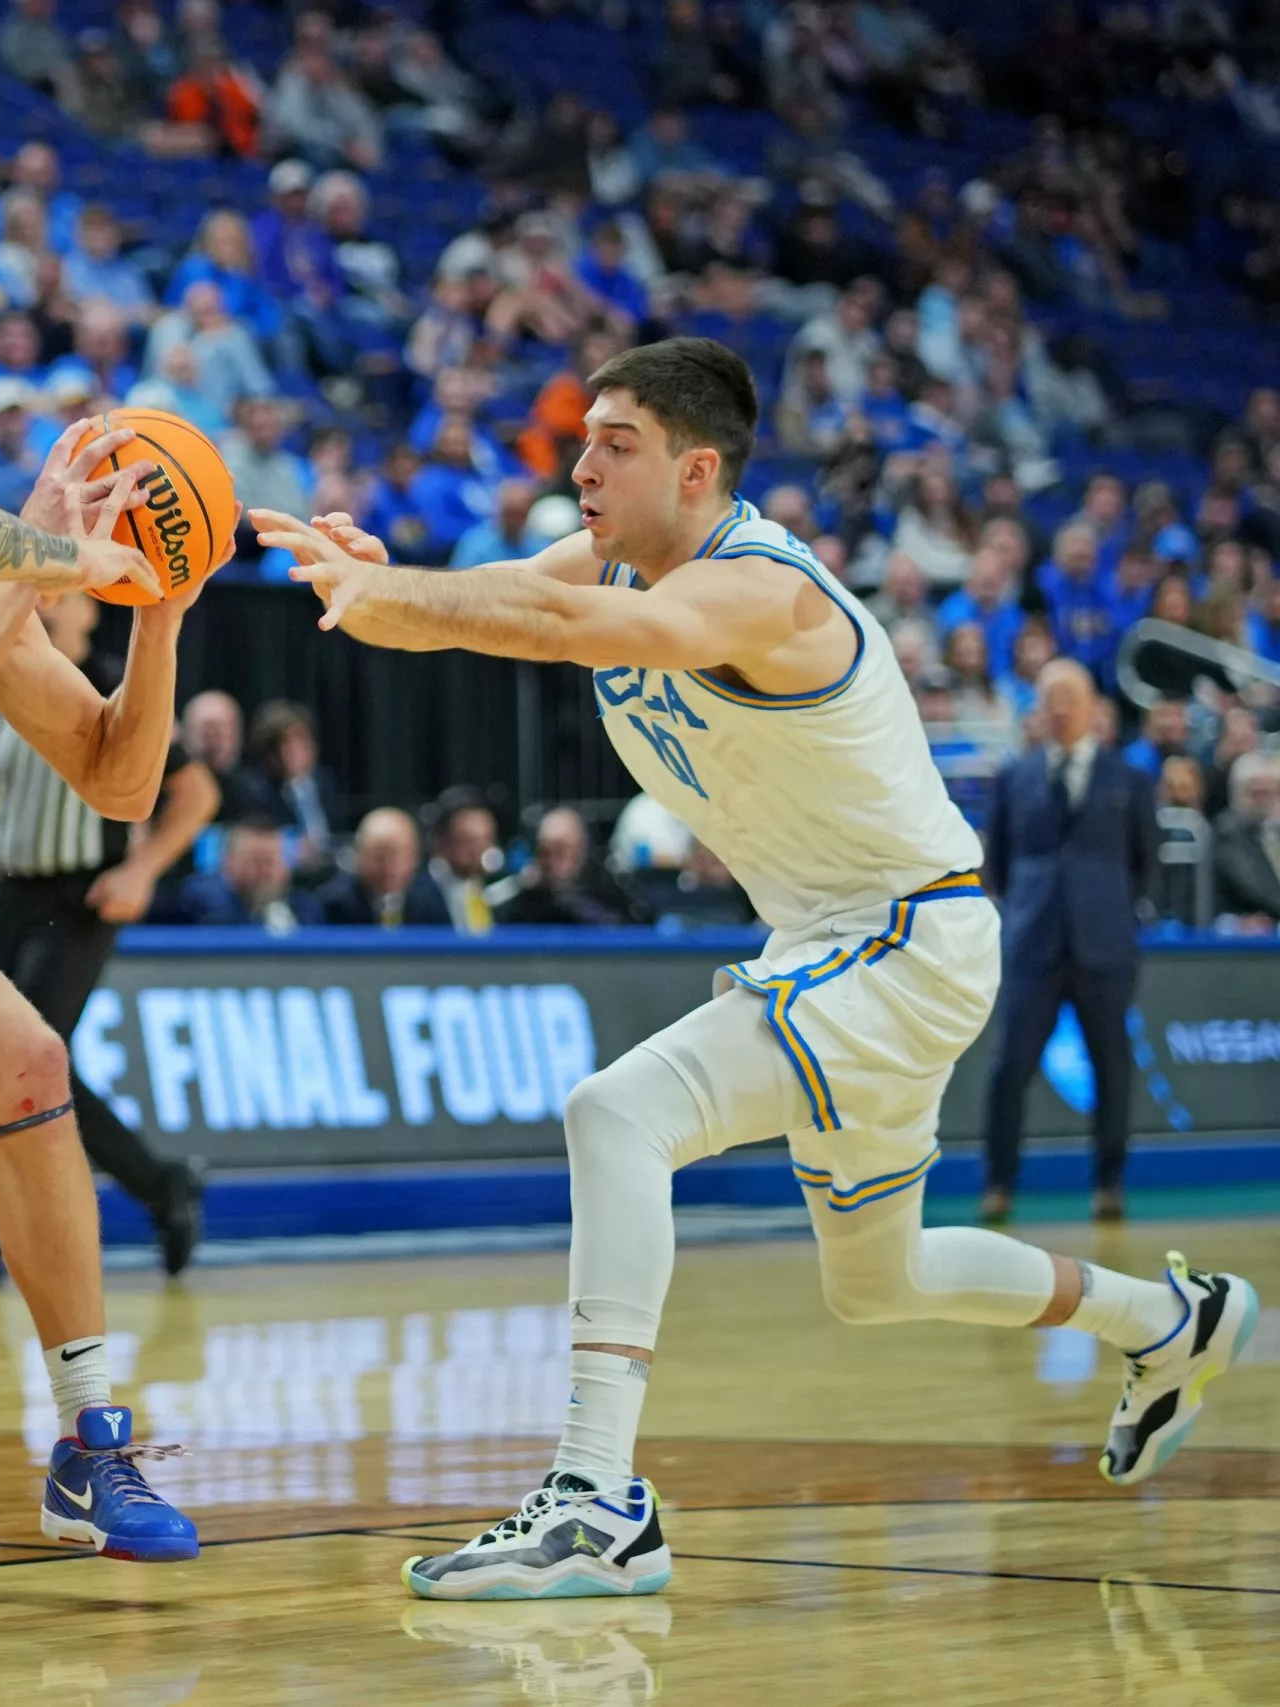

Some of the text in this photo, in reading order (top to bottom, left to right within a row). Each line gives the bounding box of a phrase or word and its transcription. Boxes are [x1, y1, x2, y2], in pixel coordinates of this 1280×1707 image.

[137, 463, 192, 590] Wilson
[626, 713, 710, 802] 10
[137, 986, 390, 1133] FINAL
[381, 983, 597, 1126] FOUR
[1165, 1018, 1280, 1065] NISSA
